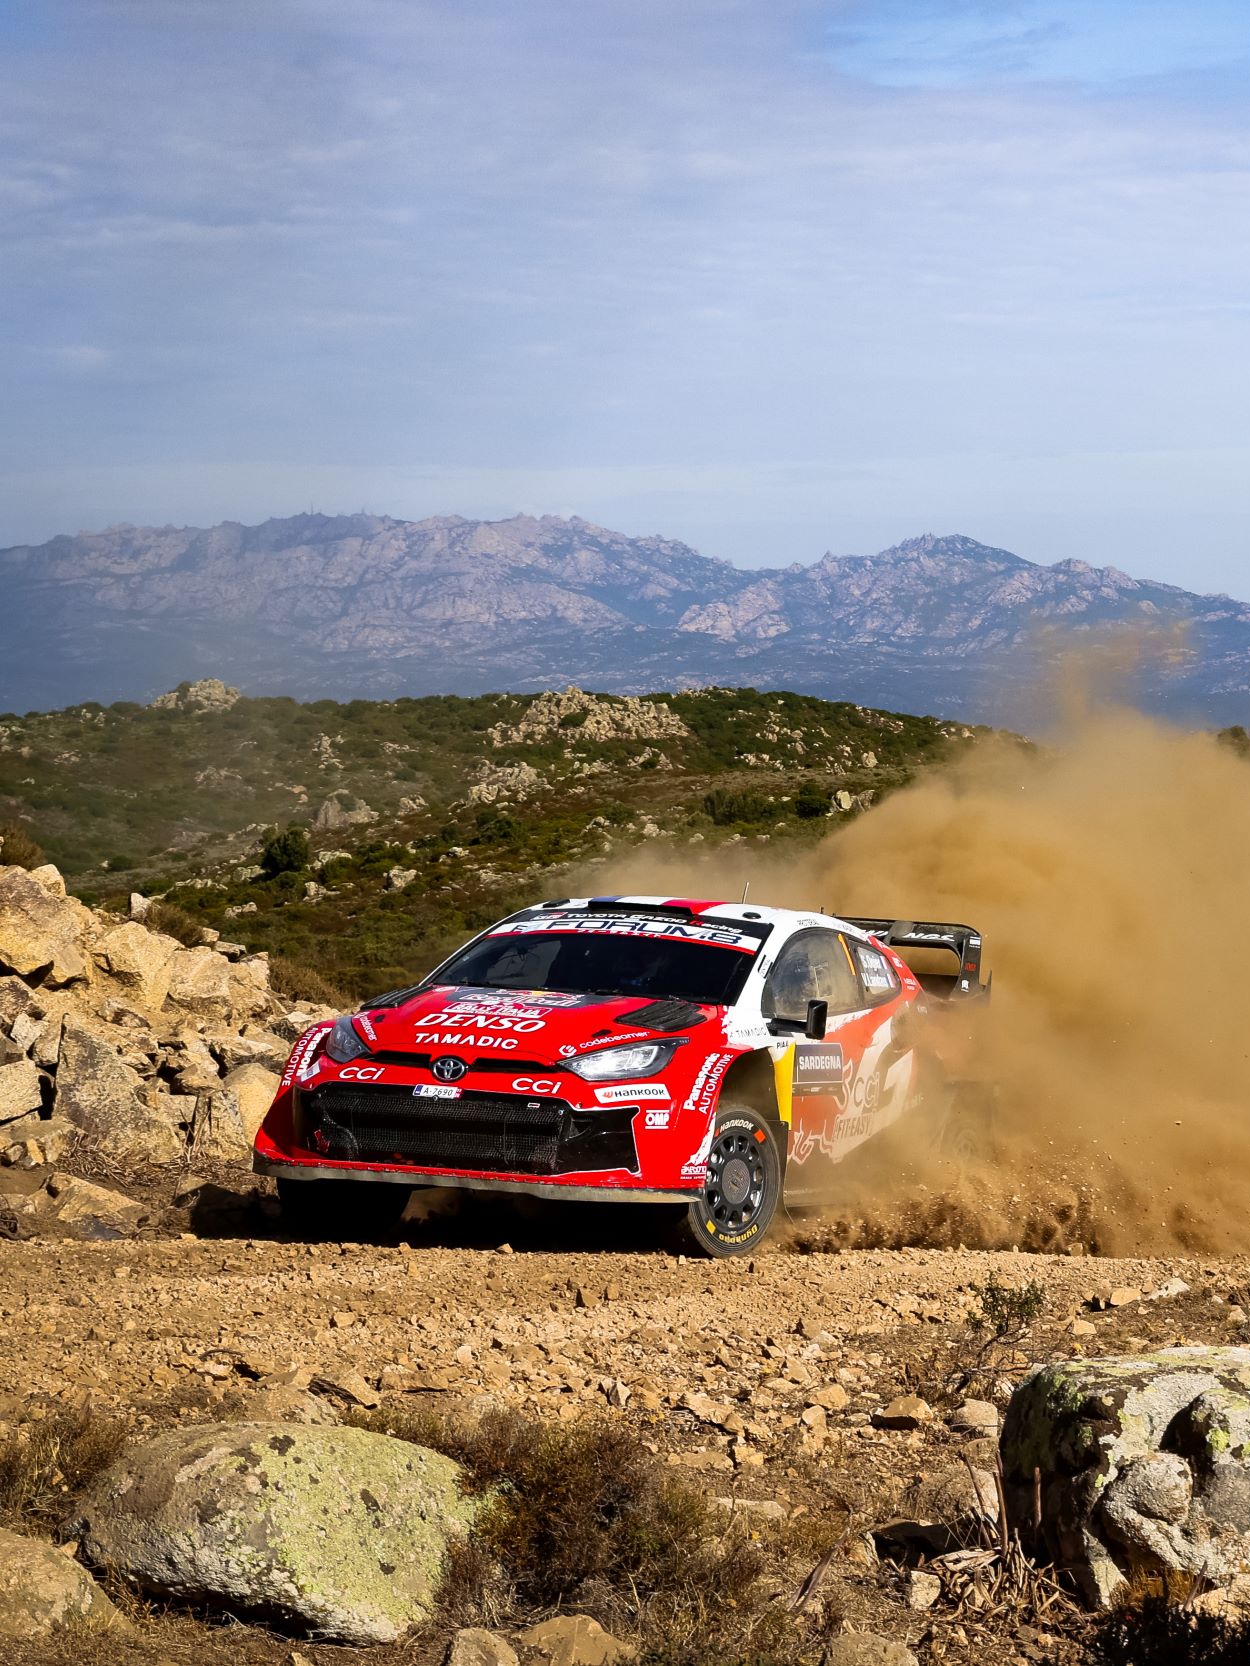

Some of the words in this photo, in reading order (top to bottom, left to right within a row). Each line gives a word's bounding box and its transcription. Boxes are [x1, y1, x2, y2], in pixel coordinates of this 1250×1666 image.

[545, 920, 742, 945] FORUM8
[628, 914, 688, 925] GAZOO
[689, 920, 743, 934] Racing
[414, 1013, 546, 1033] DENSO
[415, 1032, 519, 1050] TAMADIC
[579, 1031, 650, 1049] codebeamer
[281, 1027, 319, 1087] AUTOMOTIVE
[798, 1055, 842, 1071] SARDEGNA
[683, 1052, 721, 1111] Panasonic
[698, 1053, 735, 1115] AUTOMOTIVE
[423, 1087, 454, 1097] A-7690
[645, 1112, 670, 1126] OMP
